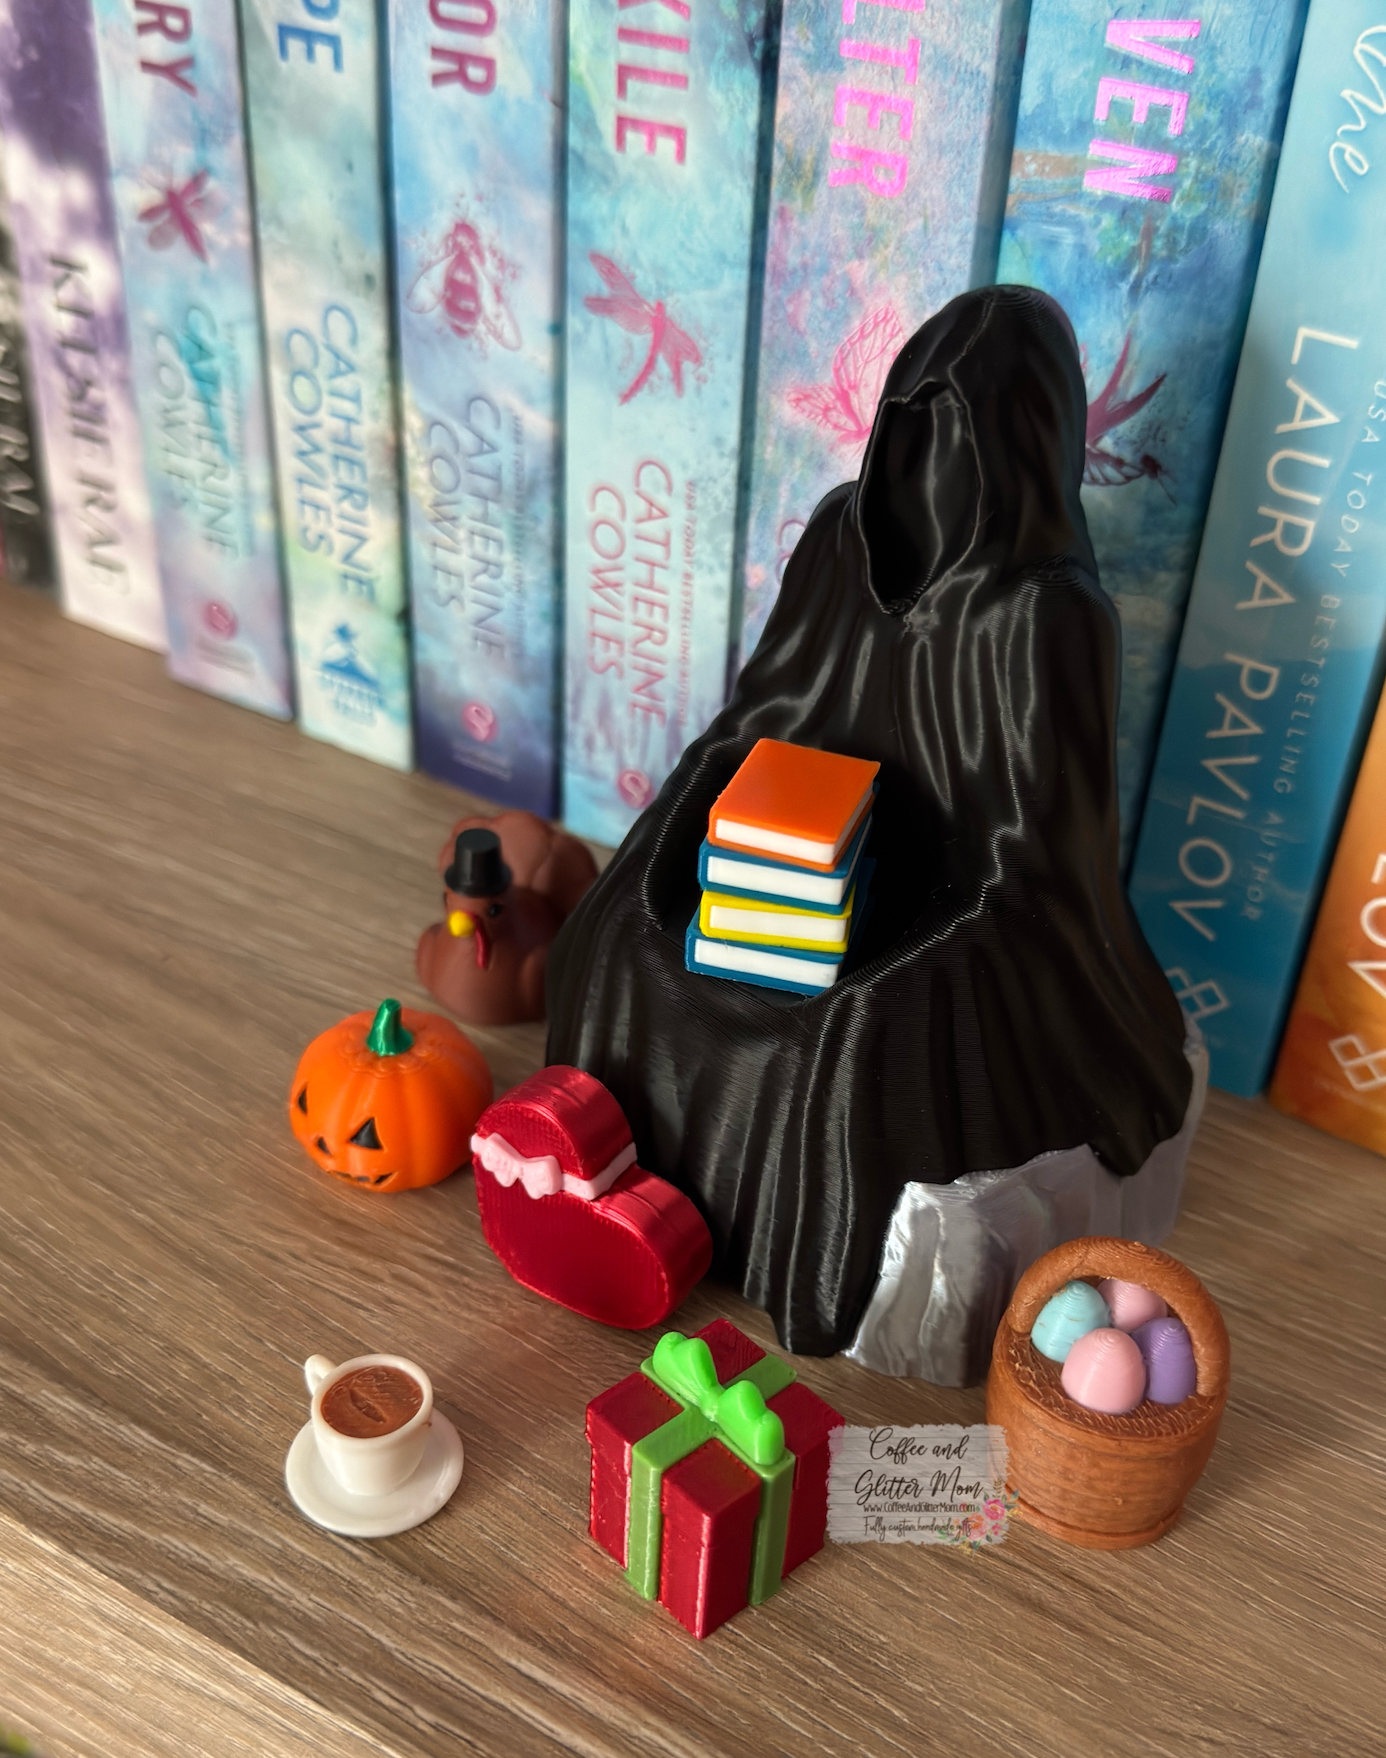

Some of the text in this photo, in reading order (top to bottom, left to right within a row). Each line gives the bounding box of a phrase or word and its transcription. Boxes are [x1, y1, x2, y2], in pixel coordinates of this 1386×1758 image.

[1084, 19, 1202, 203] VEN
[284, 327, 334, 555] COWLES
[321, 302, 378, 602] CATHERINE
[427, 420, 466, 612] COWLES
[465, 396, 507, 661] CATHERINE
[1331, 471, 1374, 578] TODAY
[588, 484, 627, 680] COWLES
[630, 459, 674, 729] CATHERINE
[1168, 326, 1359, 942] LAURA PAVLOV
[1272, 594, 1341, 795] BESTSELLING
[1241, 810, 1286, 921] AUTHOR
